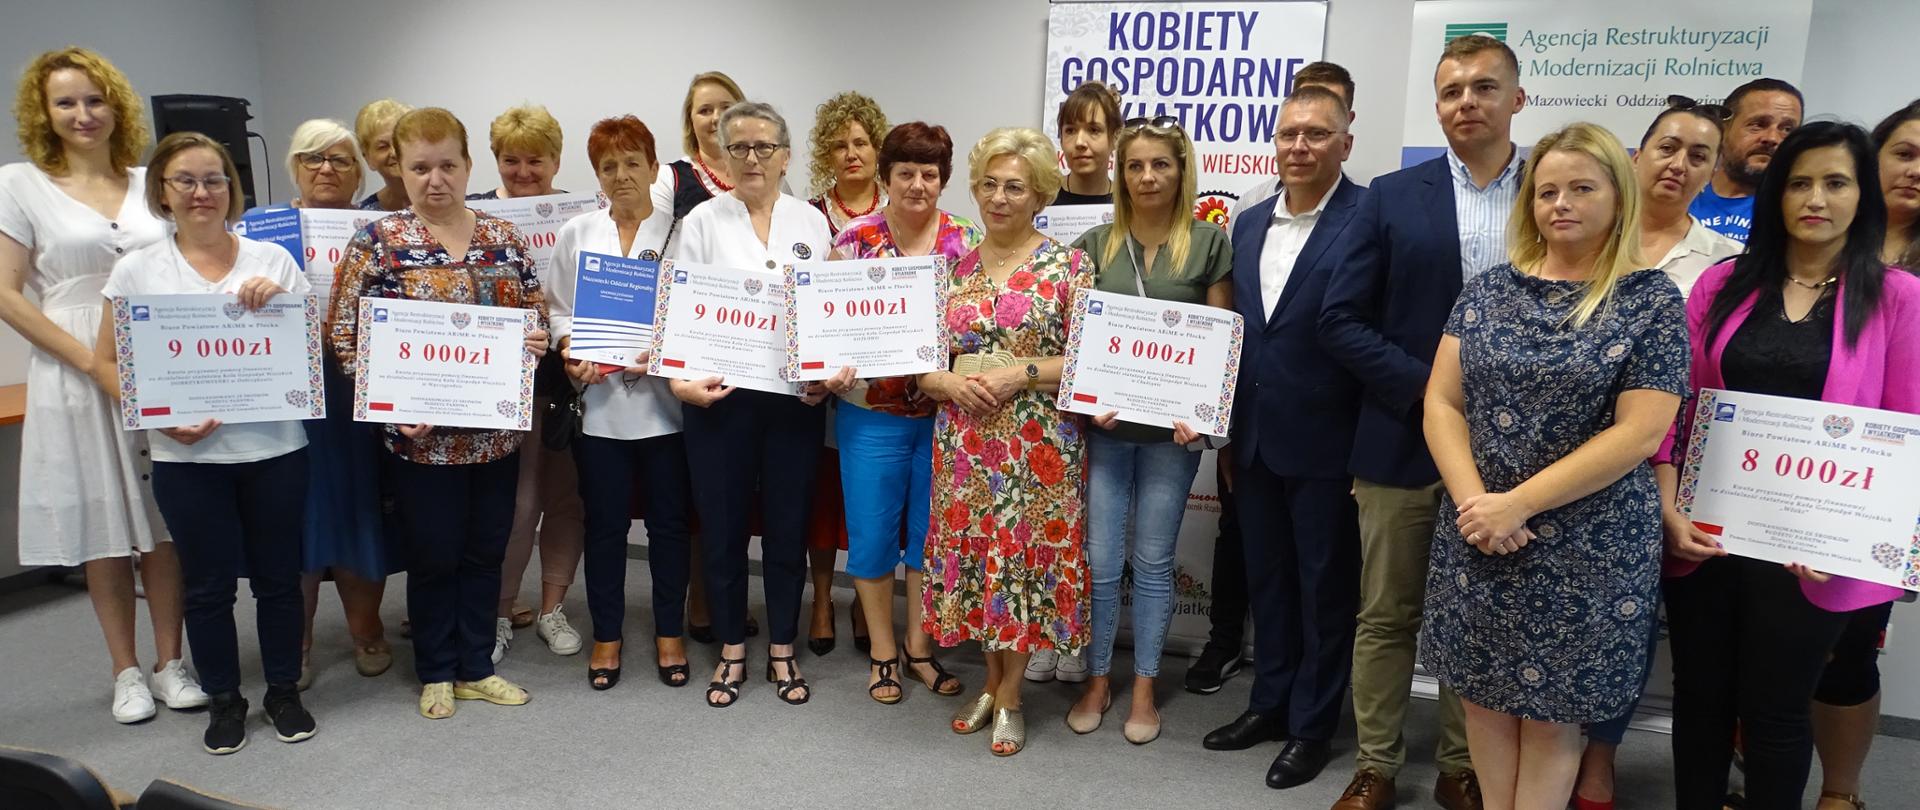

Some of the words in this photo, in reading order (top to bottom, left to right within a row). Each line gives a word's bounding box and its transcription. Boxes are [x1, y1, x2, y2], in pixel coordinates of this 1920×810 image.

[1108, 11, 1259, 51] KOBIETY
[1520, 28, 1598, 53] Agencja
[1606, 25, 1770, 53] Restrukturyzacji
[1529, 57, 1656, 82] Modernizacji
[1665, 58, 1763, 77] Rolnictwa
[1526, 94, 1608, 107] Mazowiecki
[1616, 94, 1668, 107] Oddzia
[1203, 154, 1278, 176] WIEJSKIC
[694, 303, 707, 320] 9
[716, 307, 777, 331] 000zł
[823, 303, 835, 318] 9
[845, 297, 906, 316] 000zł
[168, 340, 183, 357] 9
[197, 337, 272, 356] 000zł
[399, 342, 411, 359] 8
[423, 344, 490, 365] 000zł
[1107, 336, 1121, 353] 8
[1131, 340, 1195, 365] 000zł
[1741, 449, 1761, 471] 8
[1775, 454, 1874, 490] 000zł
